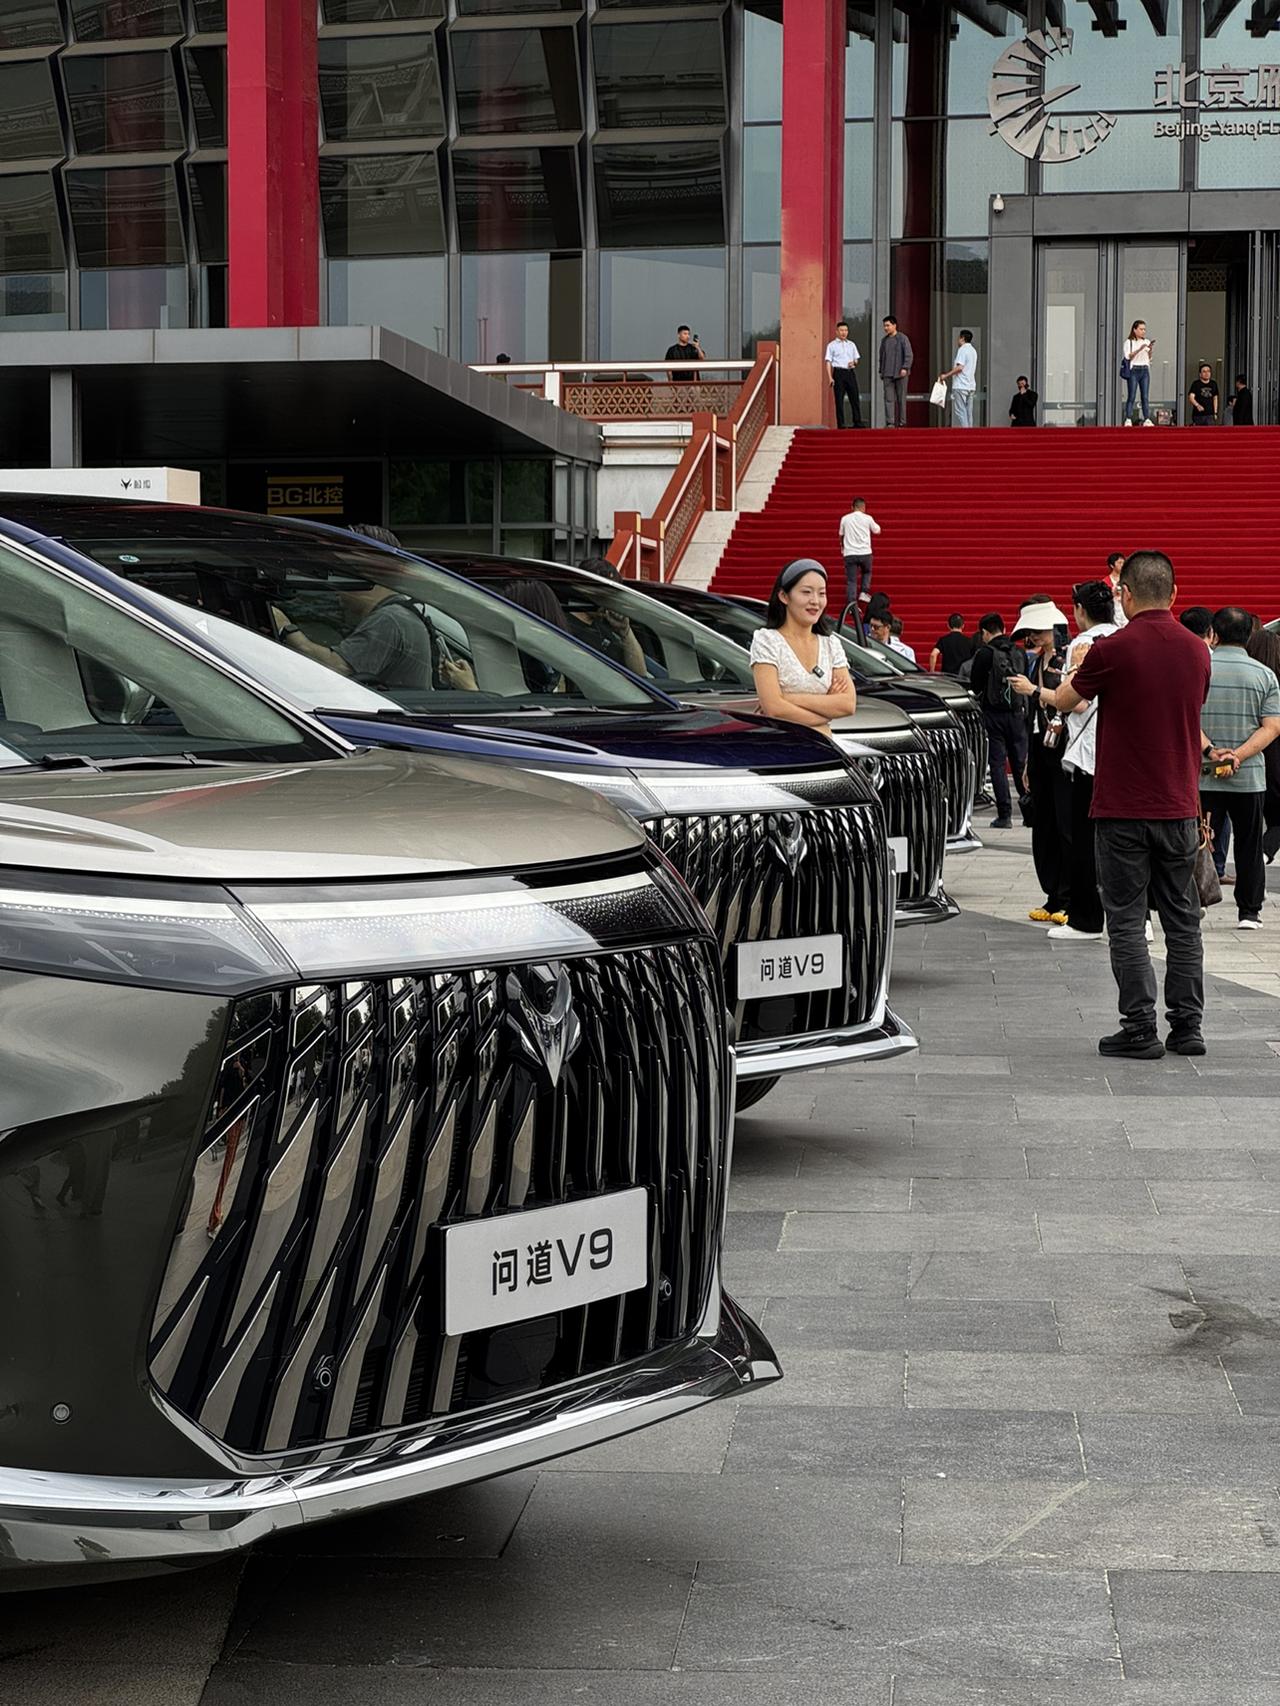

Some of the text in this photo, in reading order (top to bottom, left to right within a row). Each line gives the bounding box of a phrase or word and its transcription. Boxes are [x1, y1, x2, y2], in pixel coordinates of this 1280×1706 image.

[1153, 120, 1211, 141] Beijing
[1216, 120, 1263, 140] Yanqi
[267, 487, 344, 504] BG北控
[760, 952, 824, 982] 问道V9
[492, 1228, 613, 1296] 问道V9
